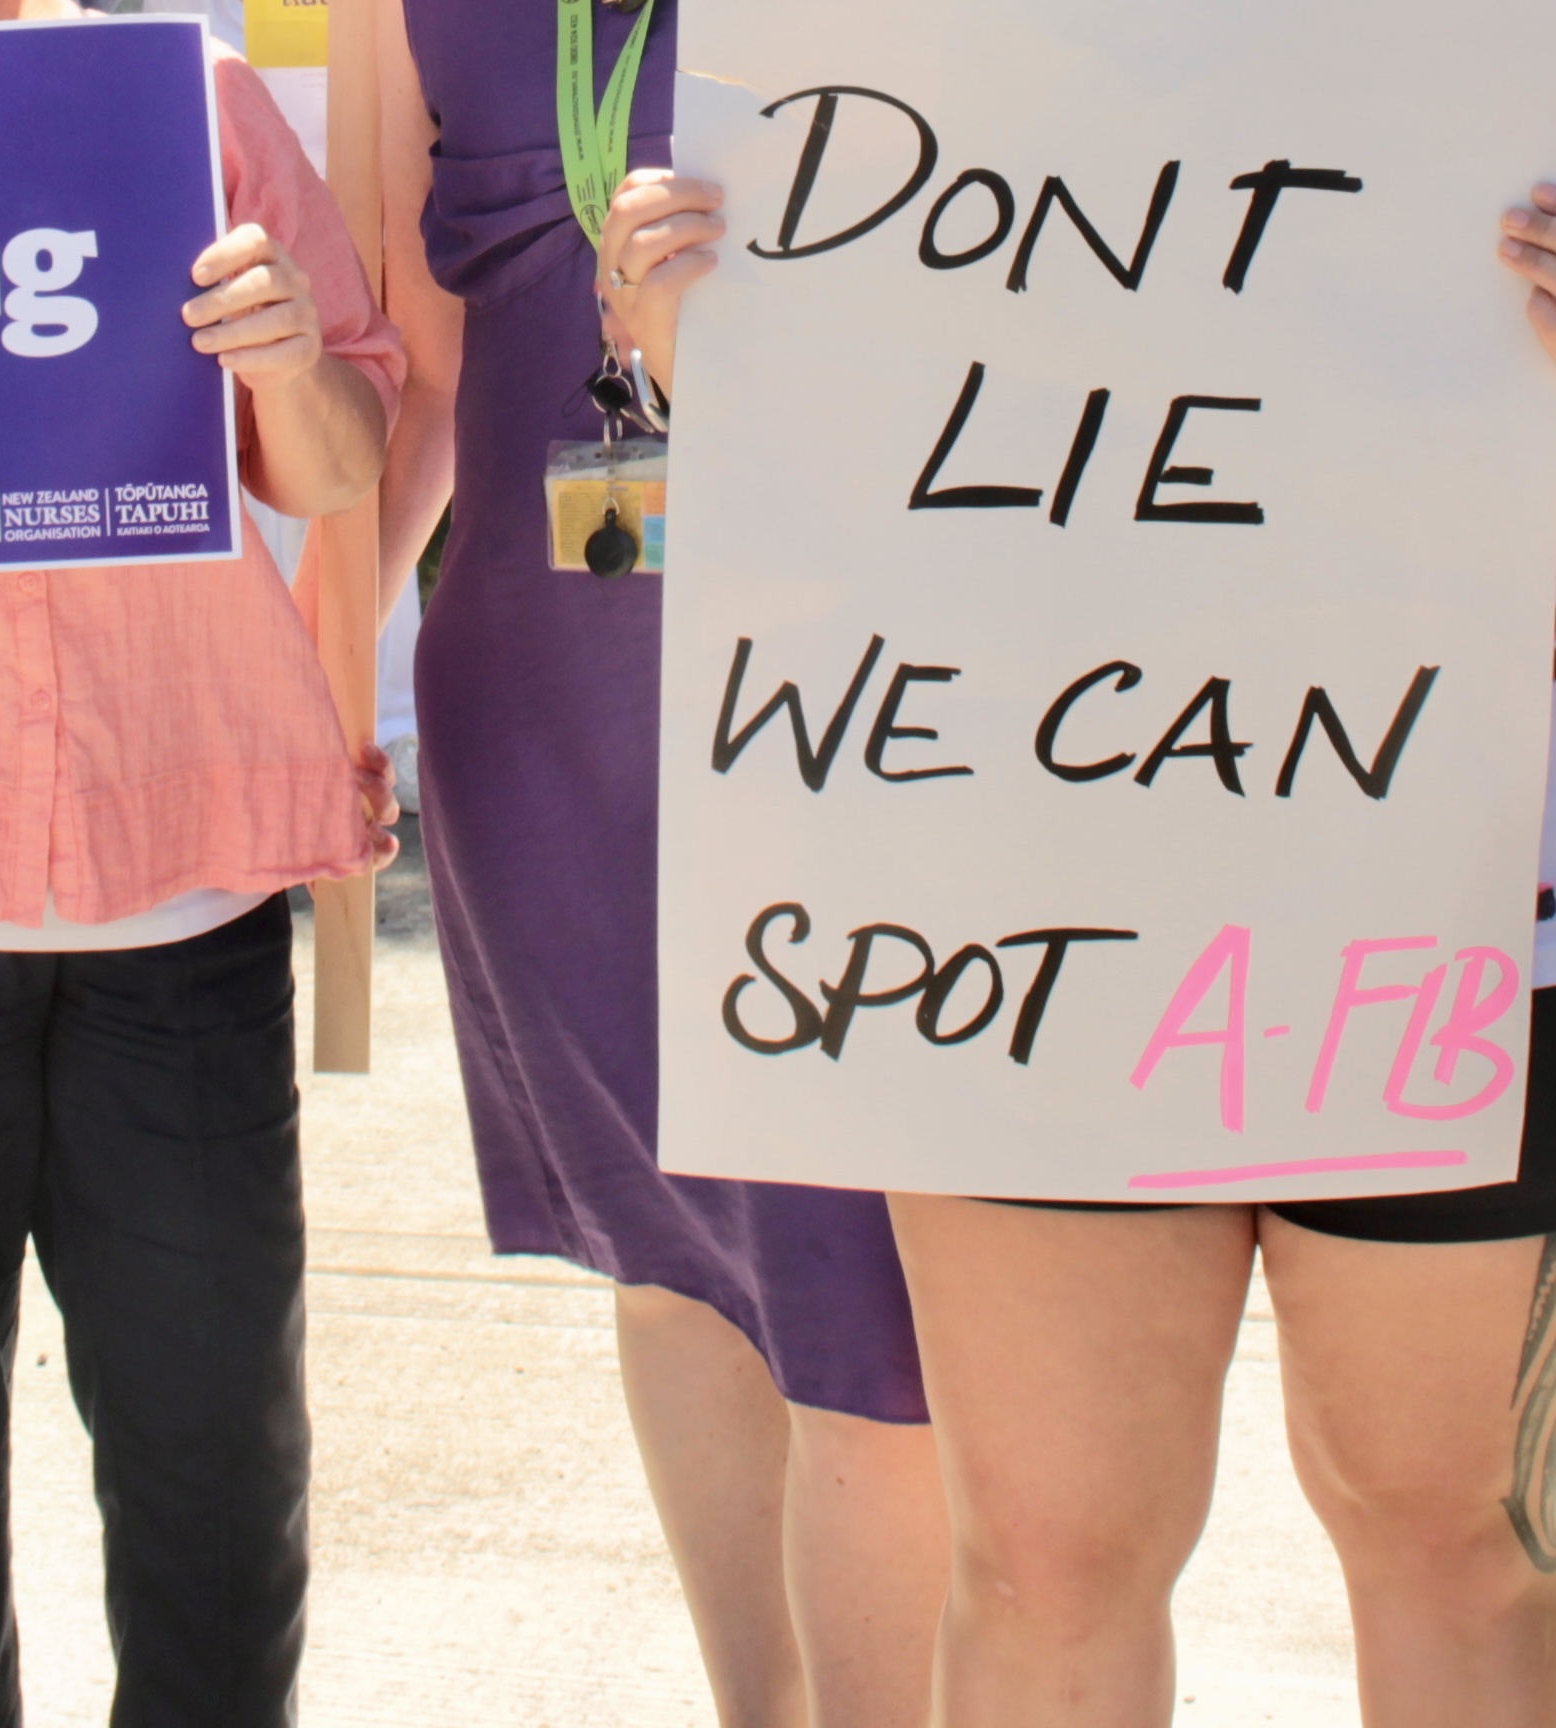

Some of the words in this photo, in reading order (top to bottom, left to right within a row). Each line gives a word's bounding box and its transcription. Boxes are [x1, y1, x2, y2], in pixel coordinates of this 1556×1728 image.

[908, 360, 1264, 528] LIE
[2, 492, 34, 506] NEW
[35, 488, 99, 504] ZEALAND
[3, 504, 100, 527] NURSES
[115, 501, 209, 523] TAPUHI
[4, 525, 101, 542] ORGANISATION
[711, 633, 975, 794] WE
[1034, 659, 1441, 801] CAN
[721, 902, 1139, 1065] SPOT
